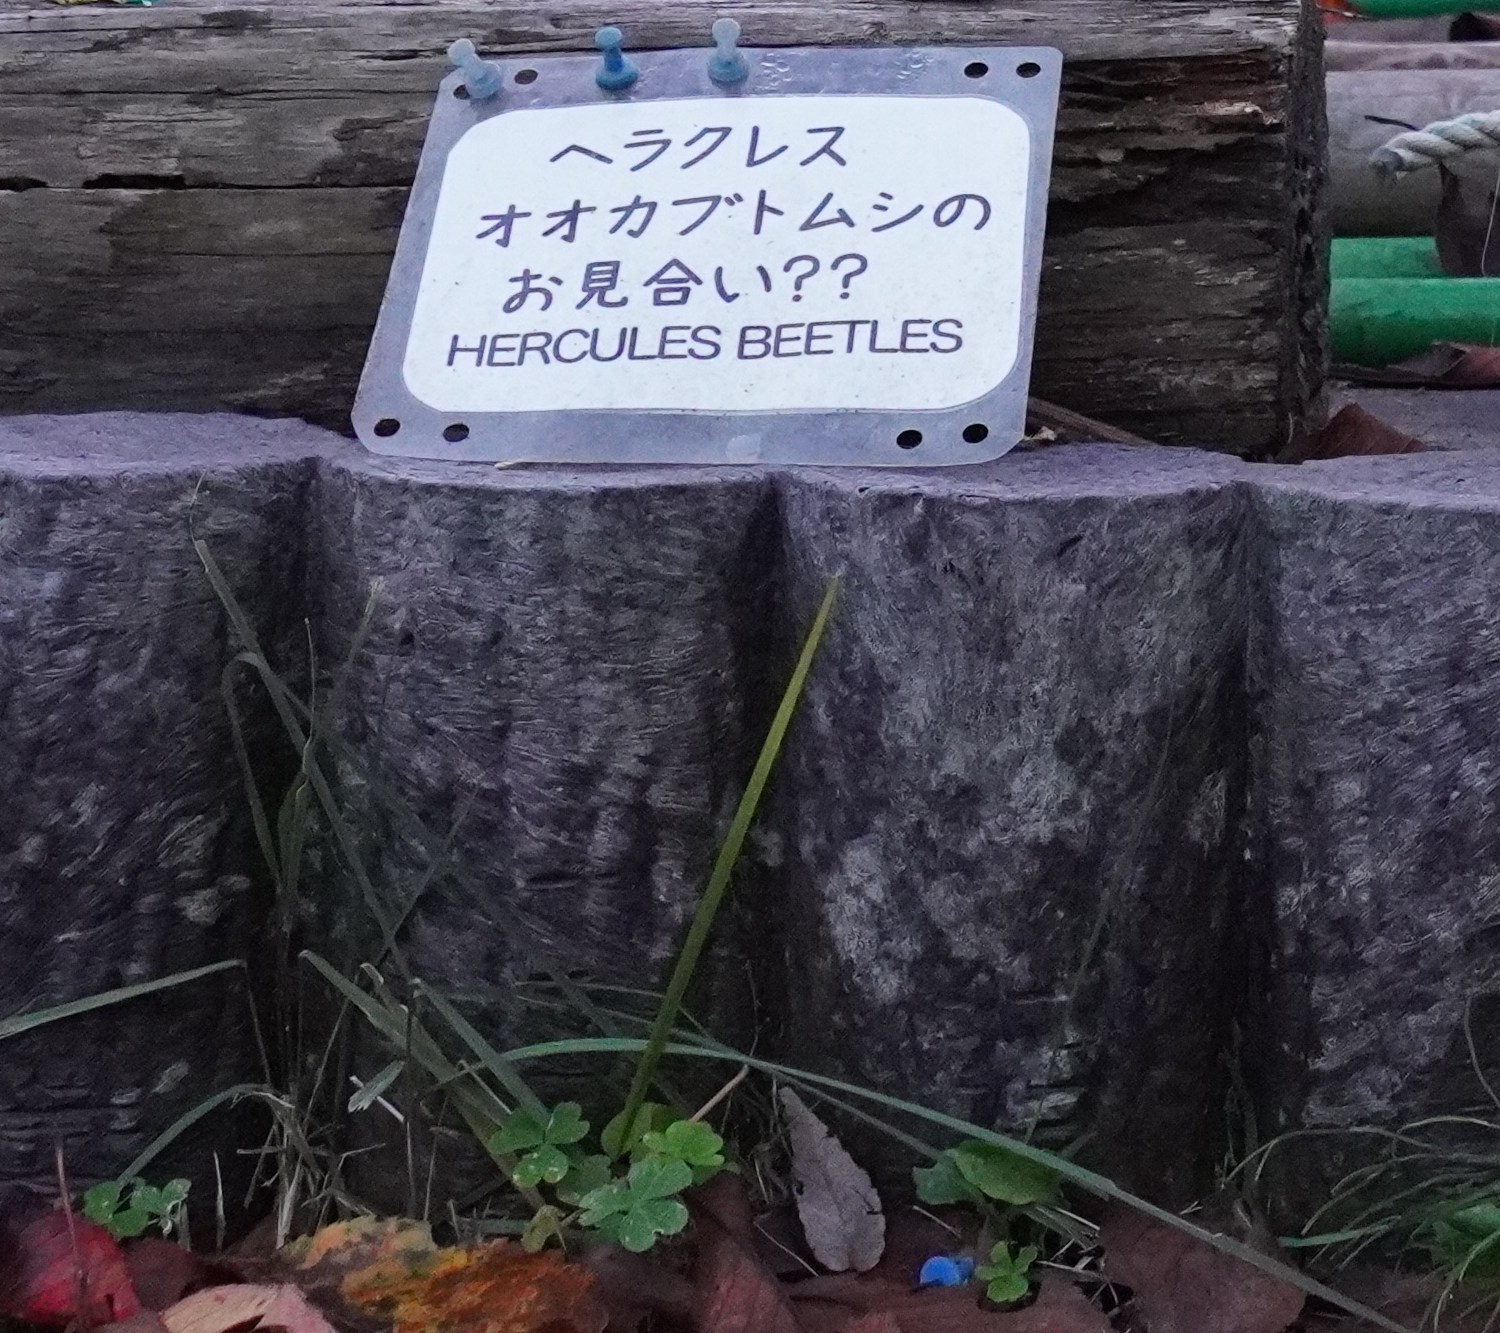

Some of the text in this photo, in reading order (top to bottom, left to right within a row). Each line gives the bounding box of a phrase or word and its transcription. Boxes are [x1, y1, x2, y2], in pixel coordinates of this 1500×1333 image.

[549, 124, 848, 172] ヘラクレス
[475, 189, 993, 248] オオカブトムシの
[446, 318, 965, 368] HERCULES BEETLES
